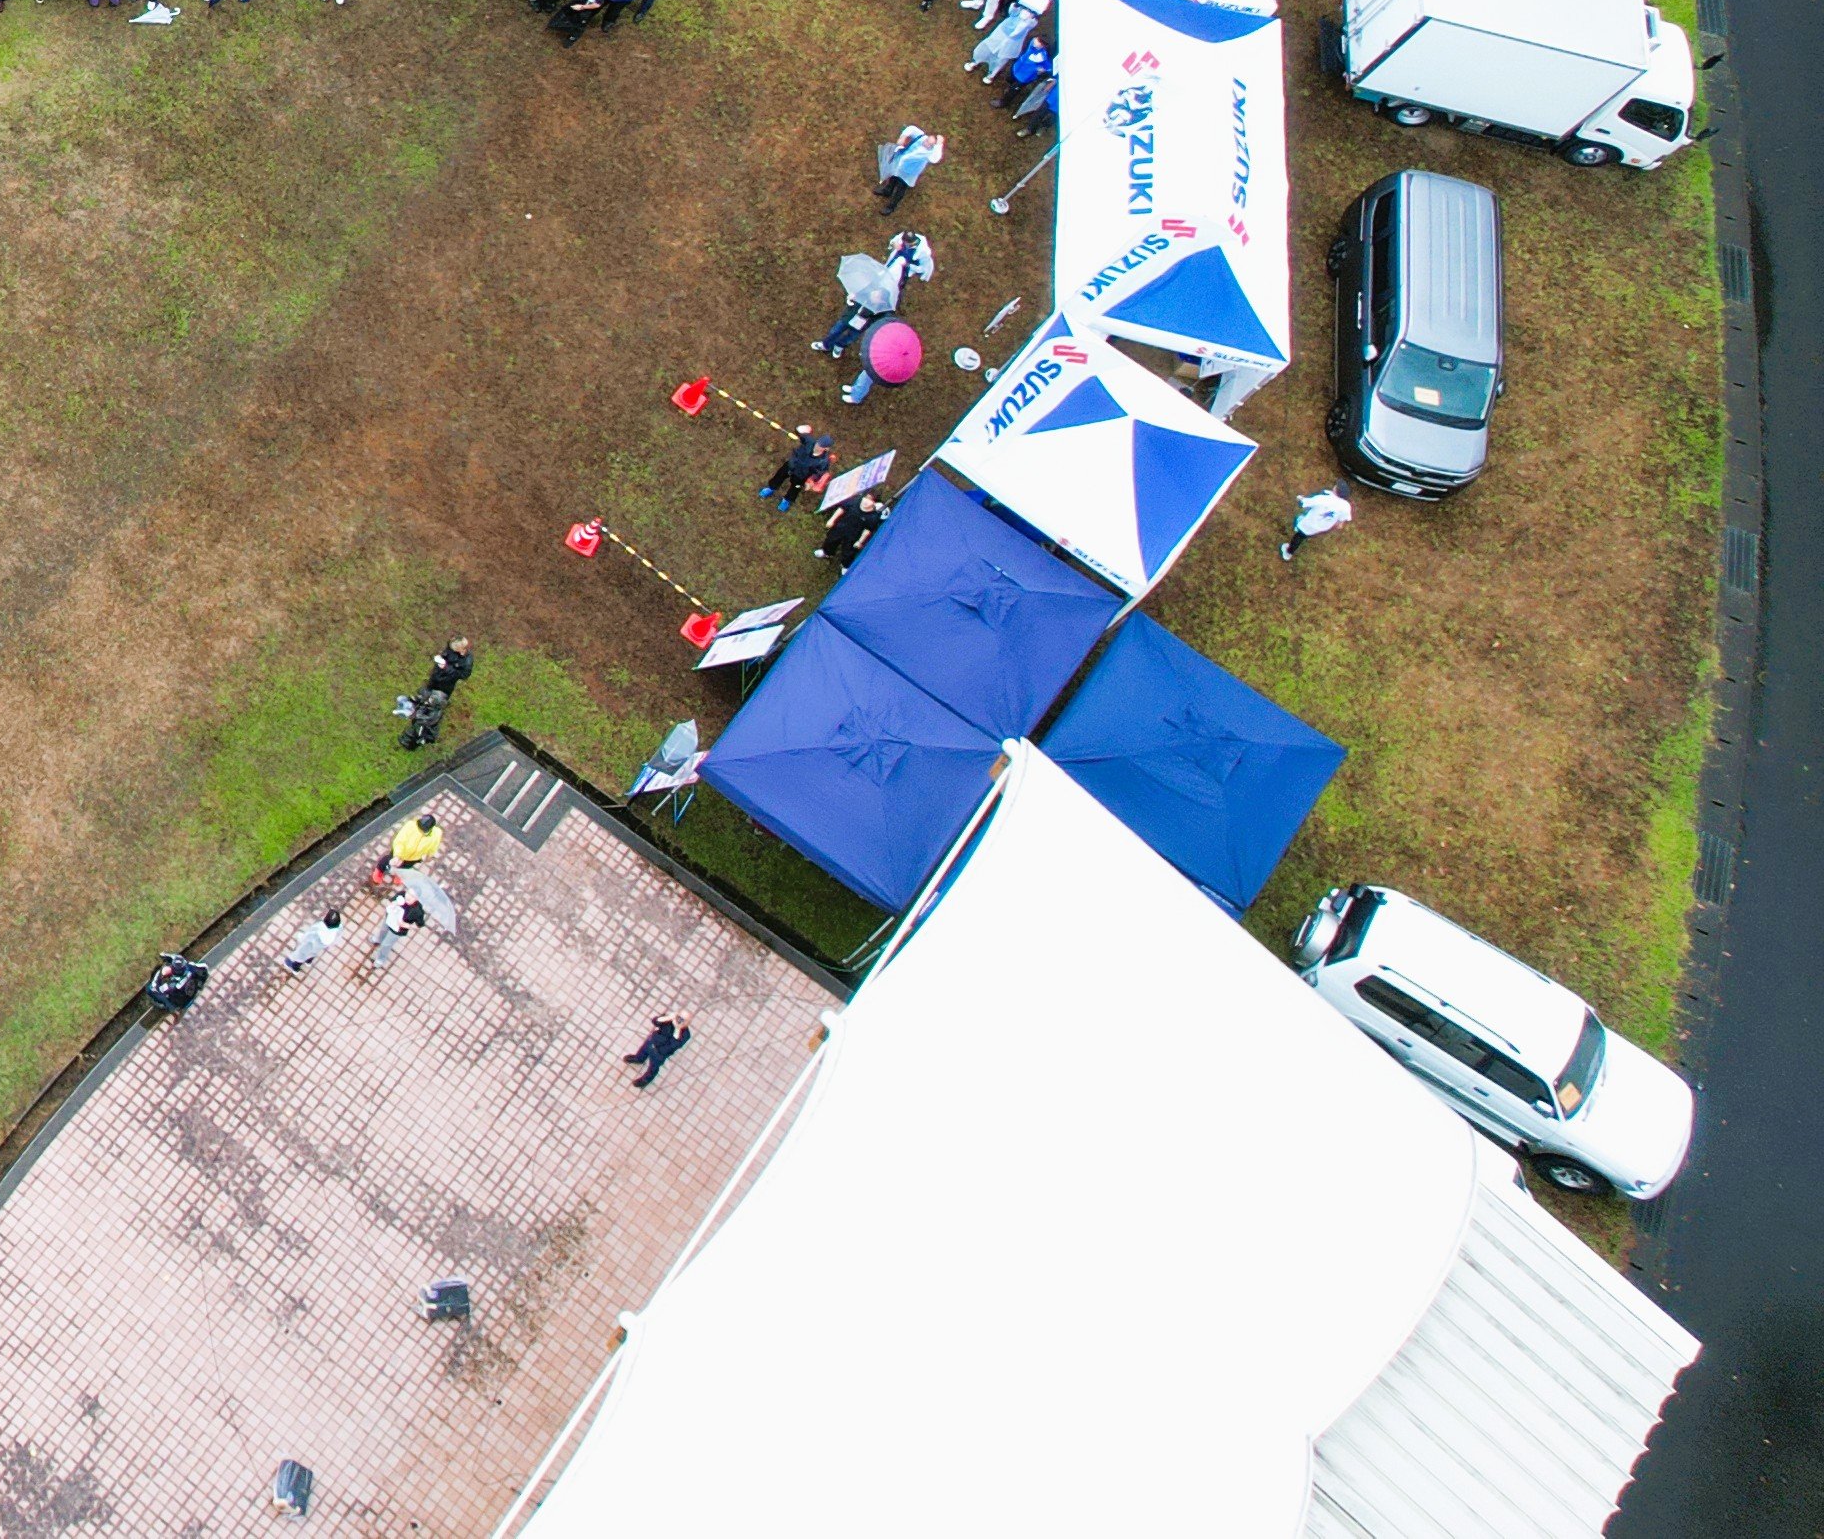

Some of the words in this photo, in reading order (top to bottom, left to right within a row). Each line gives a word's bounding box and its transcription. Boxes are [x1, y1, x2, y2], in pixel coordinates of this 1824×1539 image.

[1203, 0, 1261, 15] SUZUKI
[1128, 124, 1154, 215] ZUKI
[1231, 77, 1251, 209] SUZUKI
[1080, 233, 1170, 302] SUZUKI
[983, 358, 1063, 445] SUZUKI
